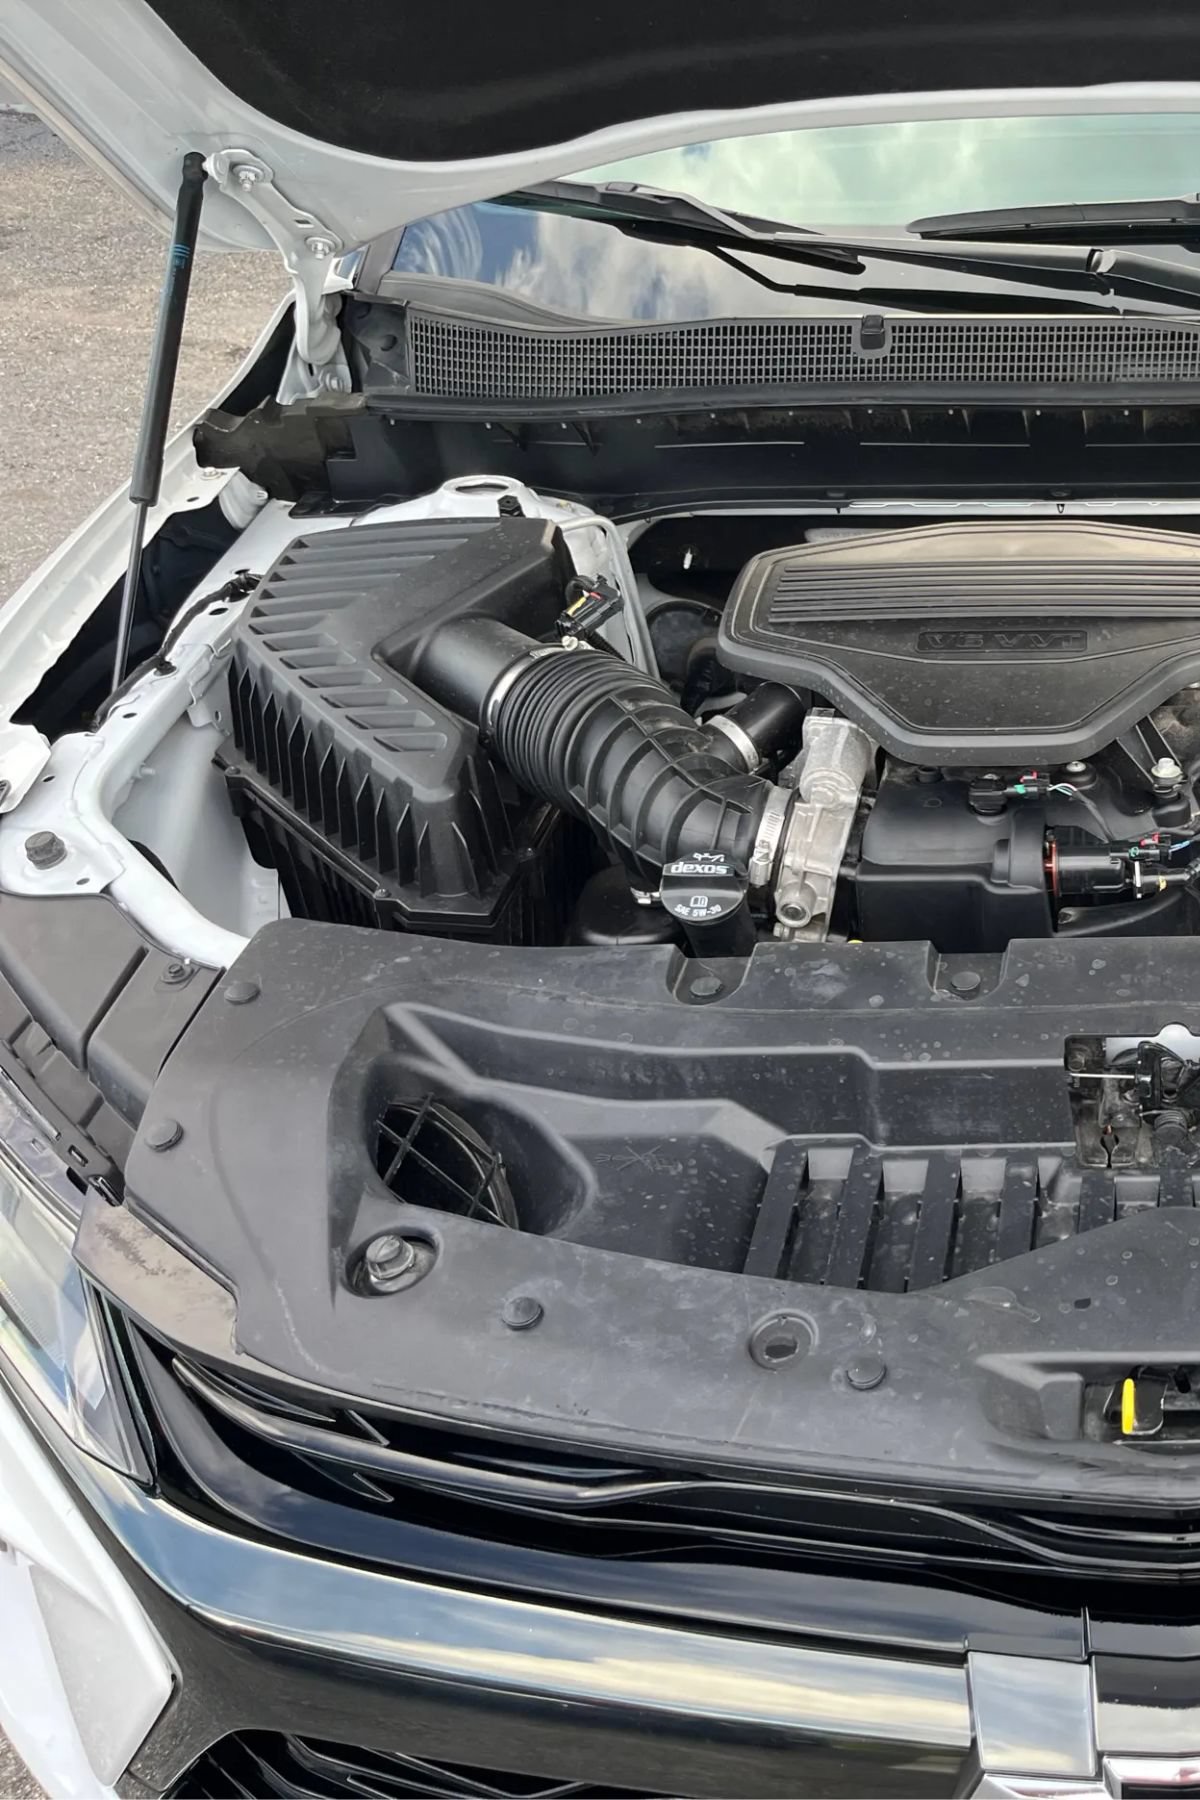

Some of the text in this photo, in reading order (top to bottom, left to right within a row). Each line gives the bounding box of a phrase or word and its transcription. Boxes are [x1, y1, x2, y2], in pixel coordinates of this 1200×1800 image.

[994, 632, 1081, 648] VVT
[670, 861, 729, 874] dexos
[674, 904, 722, 917] SAE 5W-30
